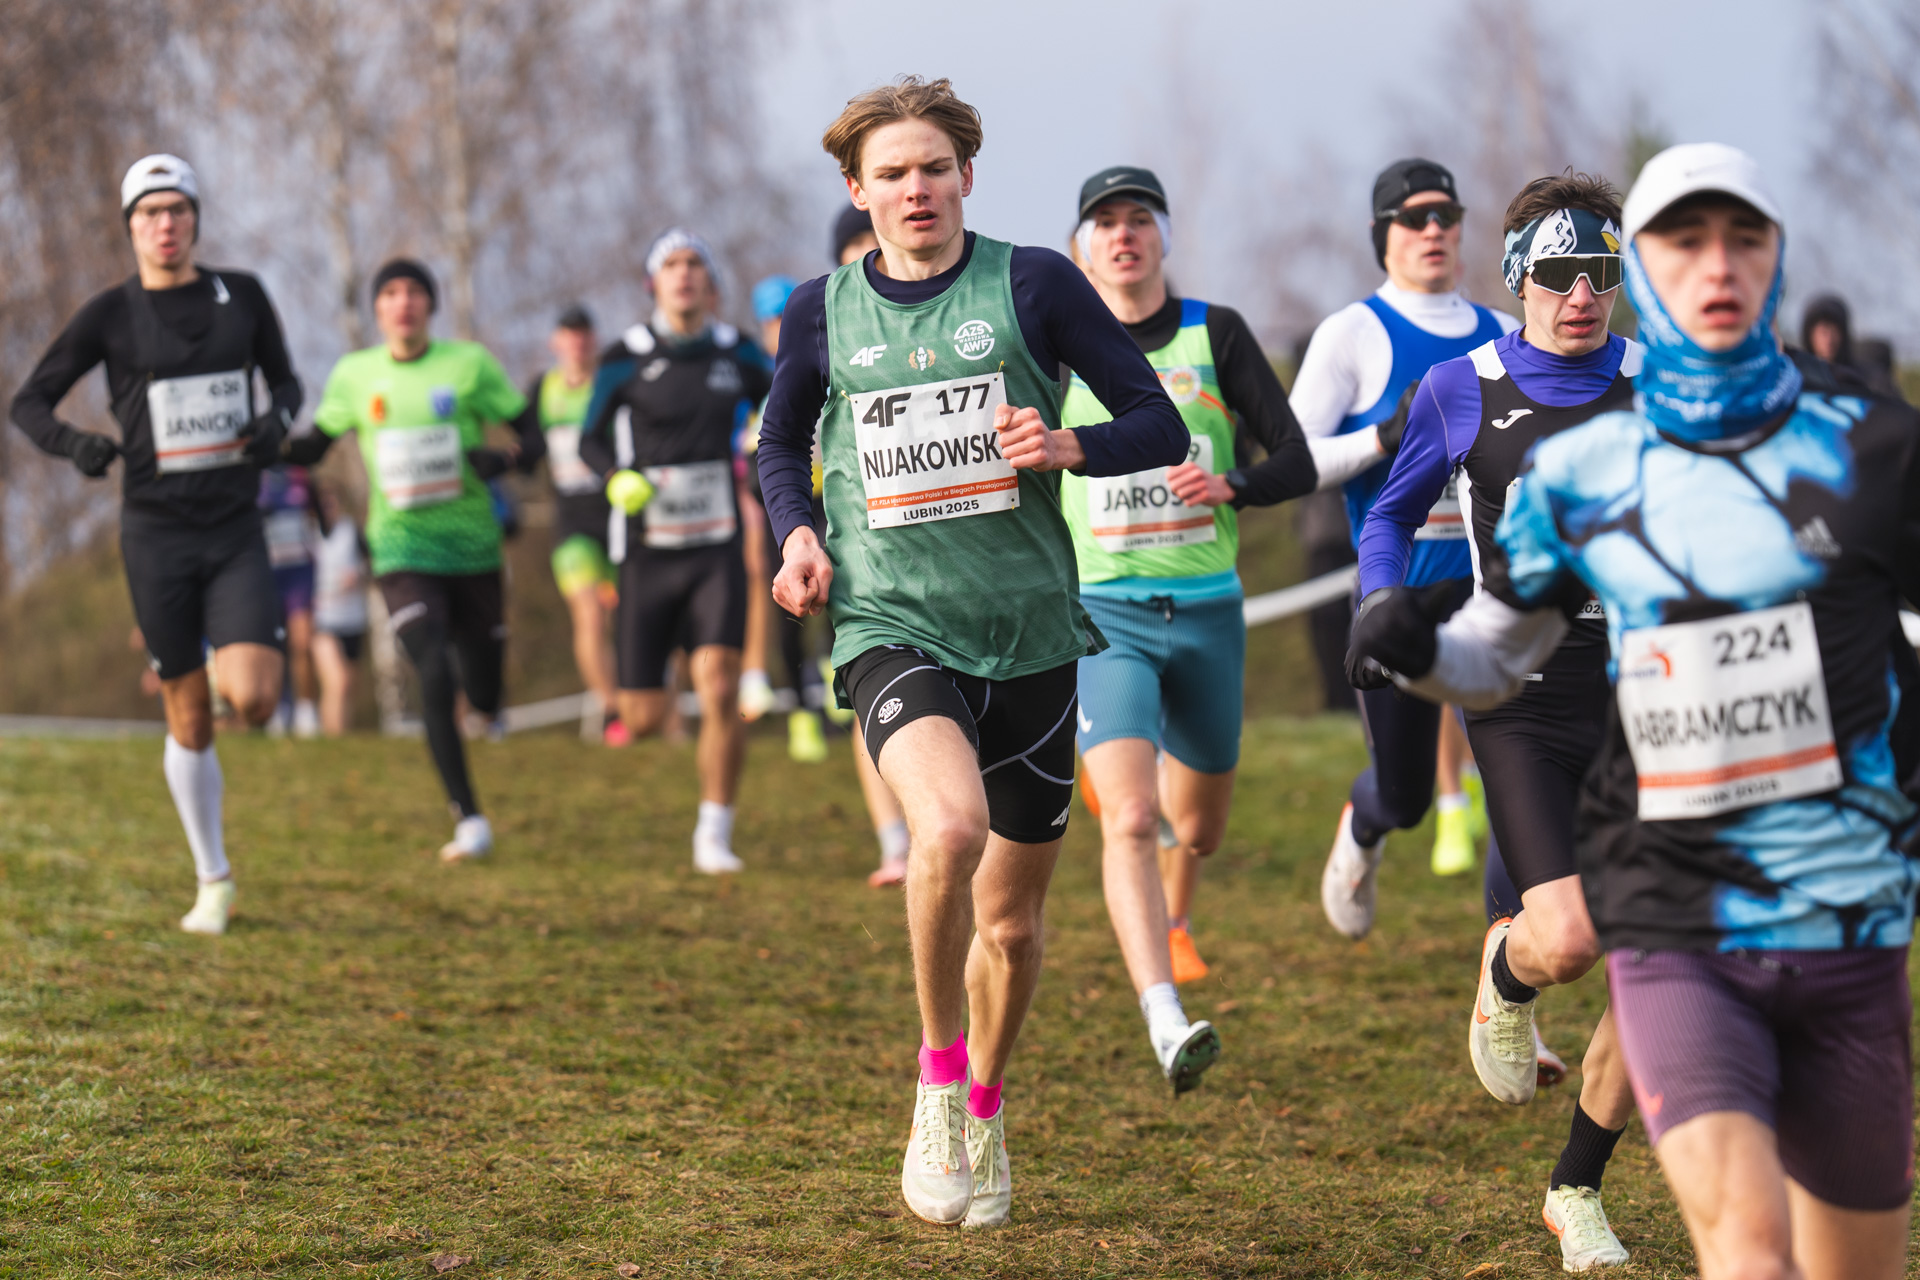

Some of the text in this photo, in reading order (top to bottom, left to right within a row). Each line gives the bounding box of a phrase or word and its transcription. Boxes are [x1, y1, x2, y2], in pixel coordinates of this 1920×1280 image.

[962, 325, 985, 338] AZS
[849, 344, 888, 367] 4F
[963, 340, 988, 353] AWF
[862, 383, 990, 428] 4F 177
[863, 431, 1003, 480] NIJAKOWSK
[891, 495, 924, 504] Mistrzostwa
[925, 491, 943, 499] Polski
[950, 485, 975, 495] Biegach
[903, 499, 980, 521] LUBIN 2025
[1580, 603, 1606, 614] 025
[1713, 620, 1791, 666] 224
[1633, 684, 1818, 747] ABRAMCZYK
